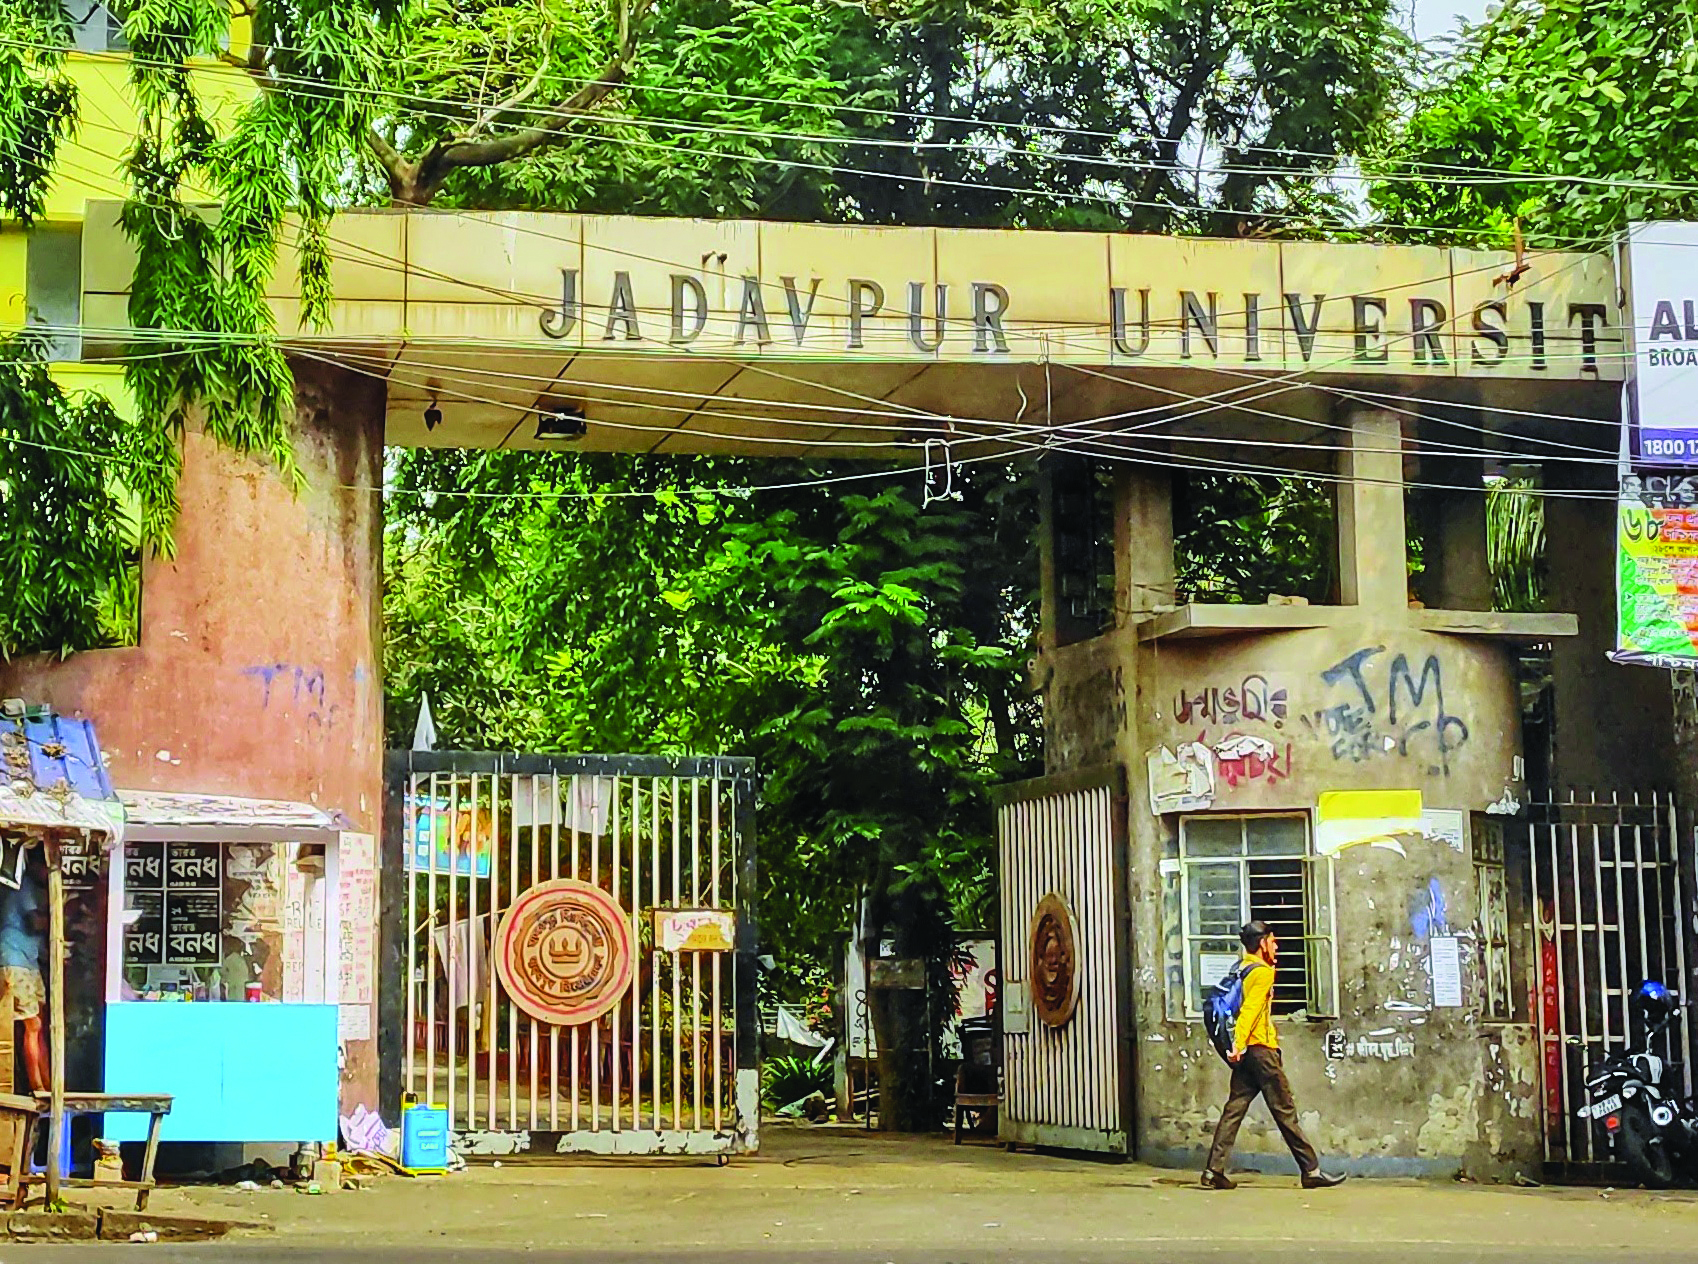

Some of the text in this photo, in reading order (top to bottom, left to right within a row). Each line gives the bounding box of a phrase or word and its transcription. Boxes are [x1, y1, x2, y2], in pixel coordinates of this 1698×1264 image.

[539, 267, 1613, 372] JADAVPUR UNIVERSIT
[1643, 439, 1685, 455] 1800
[126, 856, 161, 878] নধ
[169, 856, 218, 878] বনধ
[125, 932, 160, 954] নধ
[168, 931, 217, 954] বনধ
